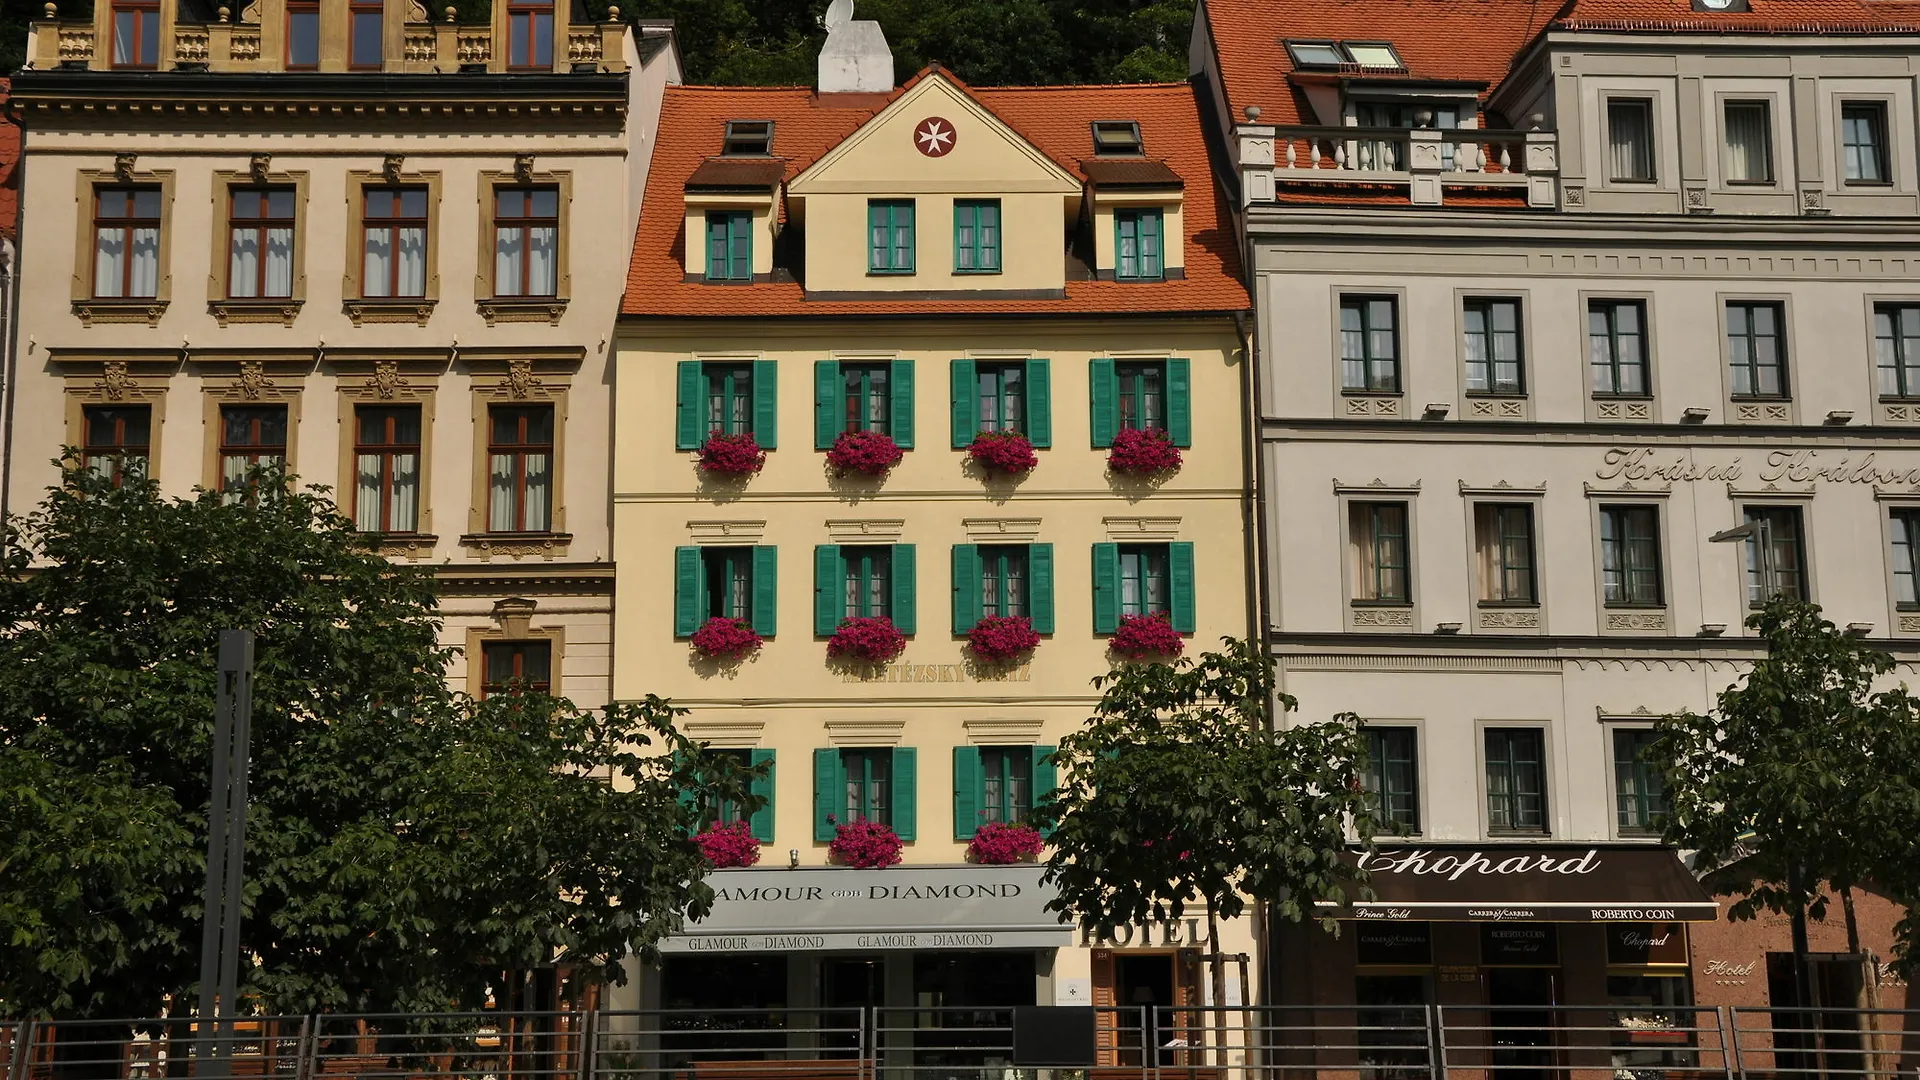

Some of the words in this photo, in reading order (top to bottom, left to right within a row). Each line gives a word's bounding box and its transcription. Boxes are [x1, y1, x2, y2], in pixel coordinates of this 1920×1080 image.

[1596, 447, 1743, 482] Krásná
[1351, 848, 1602, 881] Chopard
[714, 887, 823, 901] AMOUR
[869, 884, 1021, 899] DIAMOND
[1356, 908, 1385, 918] Prince
[1387, 908, 1411, 918] Gold
[1591, 910, 1643, 919] ROBERTO
[1646, 910, 1675, 919] COIN
[857, 935, 917, 947] GLAMOUR
[933, 934, 993, 946] DIAMOND
[1079, 918, 1210, 948] HOTEL
[1621, 931, 1670, 950] Chopard
[688, 938, 748, 950] GLAMOUR
[765, 937, 824, 949] DIAMOND
[1703, 960, 1757, 976] Hotel
